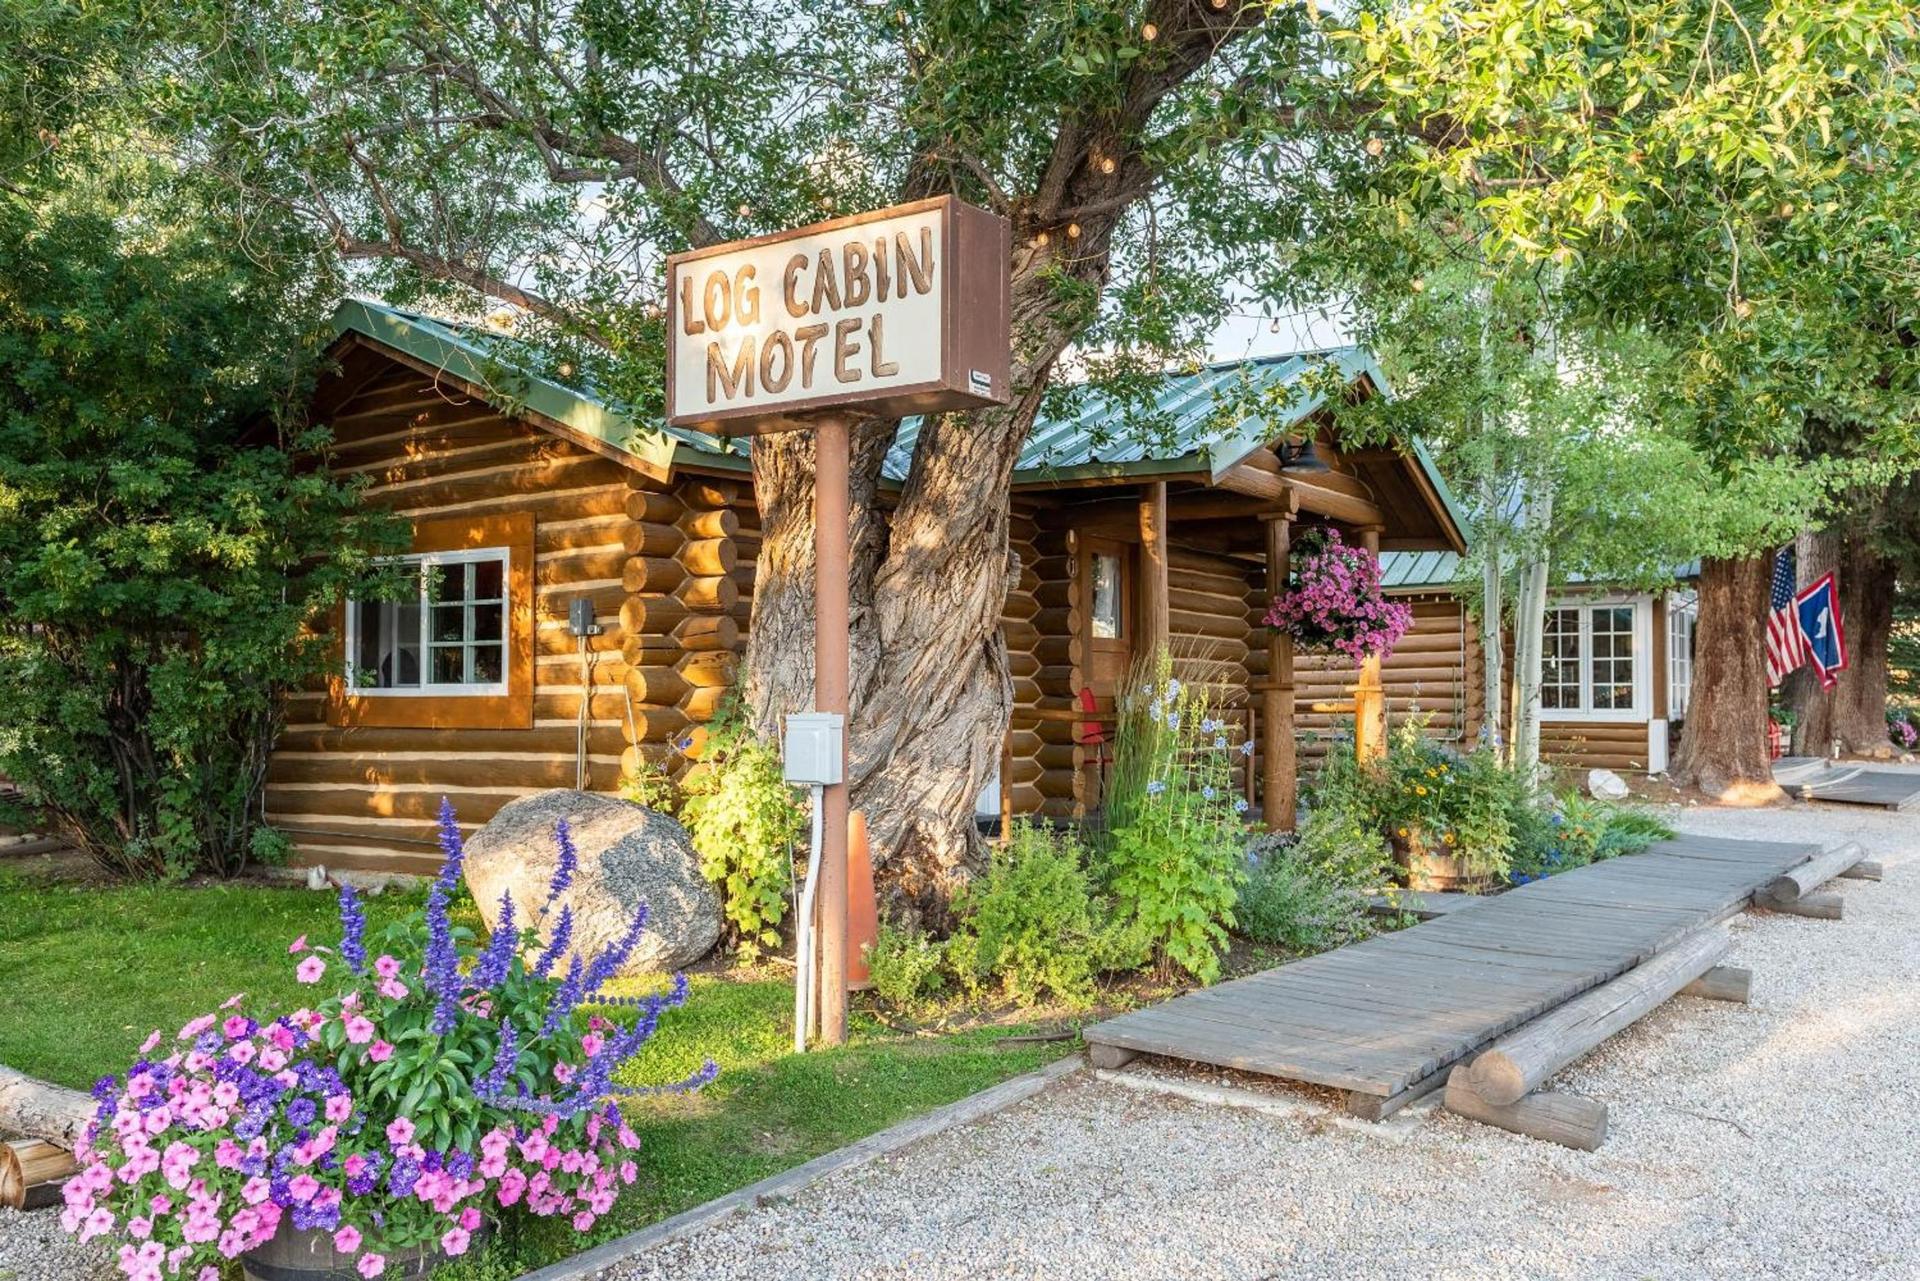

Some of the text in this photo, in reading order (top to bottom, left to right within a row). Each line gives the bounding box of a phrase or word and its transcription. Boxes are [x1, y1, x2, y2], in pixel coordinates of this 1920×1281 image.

[680, 226, 935, 336] LOG CABIN
[706, 313, 900, 404] MOTEL
